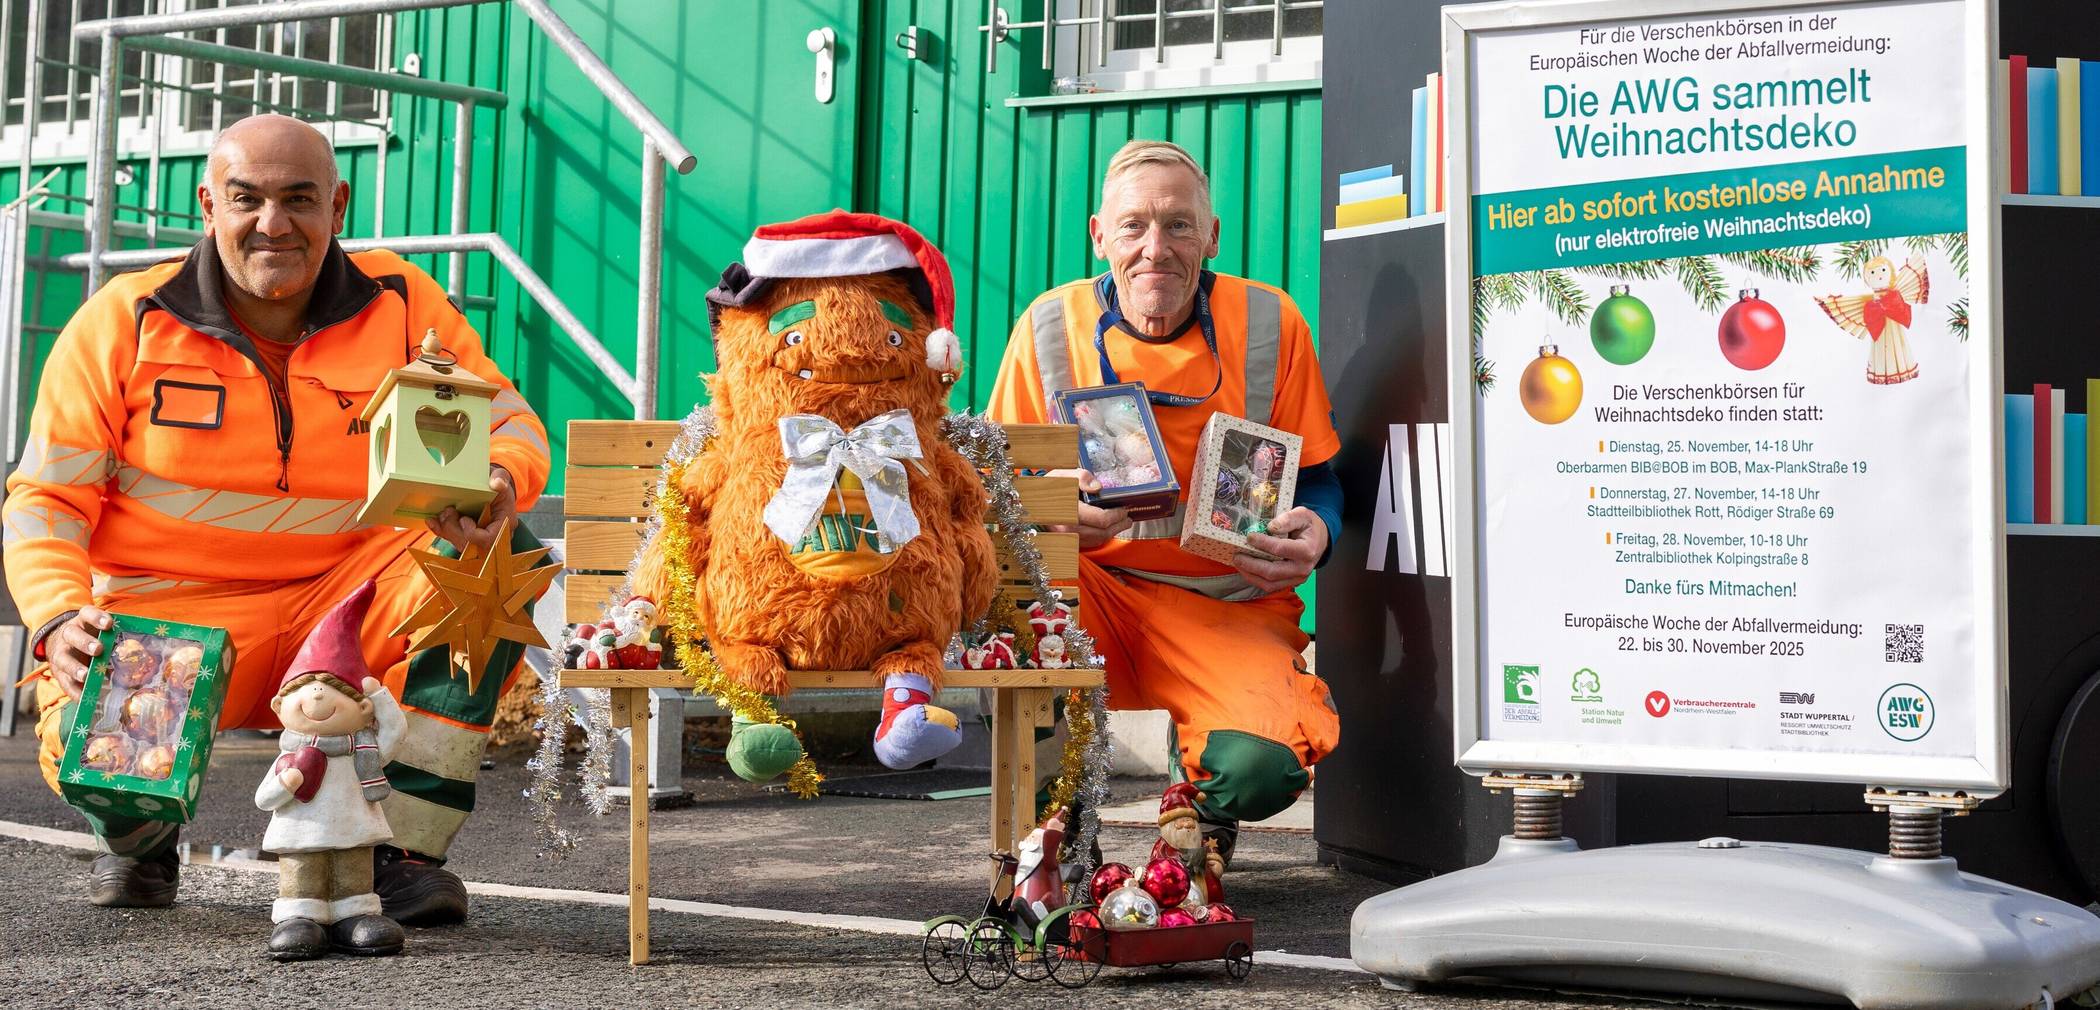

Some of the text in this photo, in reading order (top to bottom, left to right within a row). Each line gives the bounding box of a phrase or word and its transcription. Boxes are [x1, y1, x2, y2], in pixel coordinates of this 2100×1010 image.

[1580, 14, 1837, 46] Für die Verschenkbörsen in der
[1529, 35, 1891, 73] Europäischen Woche der Abfallvermeidung:
[1545, 68, 1871, 118] Die AWG sammelt
[1555, 113, 1856, 159] Weihnachtsdeko
[1488, 165, 1944, 230] Hier ab sofort kostenlose Annahme
[1555, 205, 1870, 258] (nur elektrofreie Weihnachtsdeko)
[1613, 382, 1805, 401] Die Verschenkbörsen für
[1594, 405, 1823, 423] Weihnachtsdeko finden statt:
[1609, 439, 1814, 456] Dienstag, 25. November, 14-18 Uhr
[1556, 460, 1867, 475] Oberbarmen BIB@BOB im BOB, Max-PlankStraße 19
[1600, 486, 1821, 503] Donnerstag, 27. November, 14-18 Uhr
[1587, 504, 1835, 522] Stadtteilbibliothek Rott, Rödiger Straße 69
[1616, 532, 1809, 549] Freitag, 28. November, 10-18 Uhr
[1615, 550, 1809, 568] Zentralbibliothek Kolpingstraße 8
[1625, 578, 1797, 598] Danke fürs Mitmachen!
[1564, 612, 1863, 639] Europäische Woche der Abfallvermeidung:
[1618, 636, 1805, 657] 22. bis 30. November 2025
[1581, 708, 1625, 717] Station Natur
[1673, 698, 1756, 709] Verbraucherzentrale
[1673, 707, 1737, 716] Nordrhein-Westfalen
[1887, 697, 1924, 712] AWG
[1581, 716, 1622, 725] und Umwelt
[1780, 711, 1803, 720] STADT
[1805, 713, 1851, 721] WUPPERTAL
[1889, 713, 1922, 728] ESW
[1806, 723, 1852, 731] UMWELTSCHUTZ
